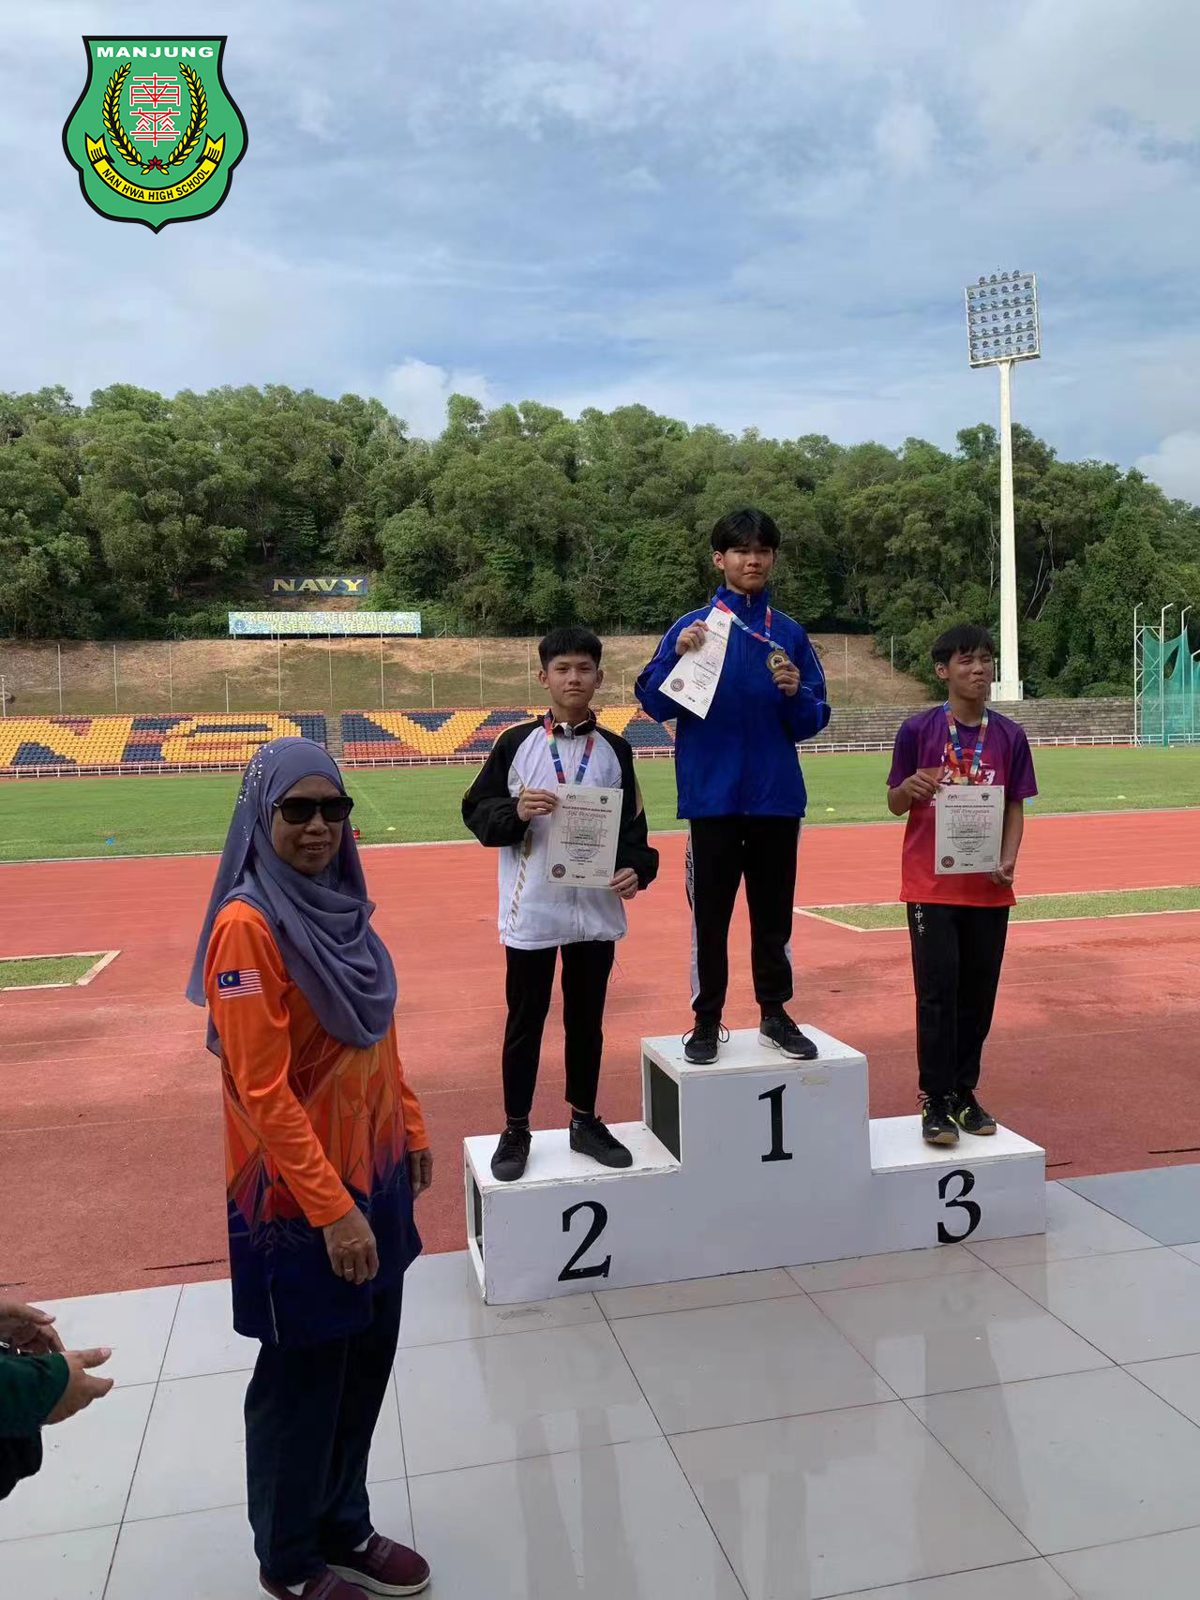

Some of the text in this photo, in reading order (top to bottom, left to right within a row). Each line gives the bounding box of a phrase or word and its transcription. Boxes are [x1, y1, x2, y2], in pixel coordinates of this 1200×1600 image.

[272, 578, 364, 592] NAVY
[758, 1083, 793, 1163] 1
[557, 1200, 612, 1283] 2
[936, 1169, 982, 1244] 3
